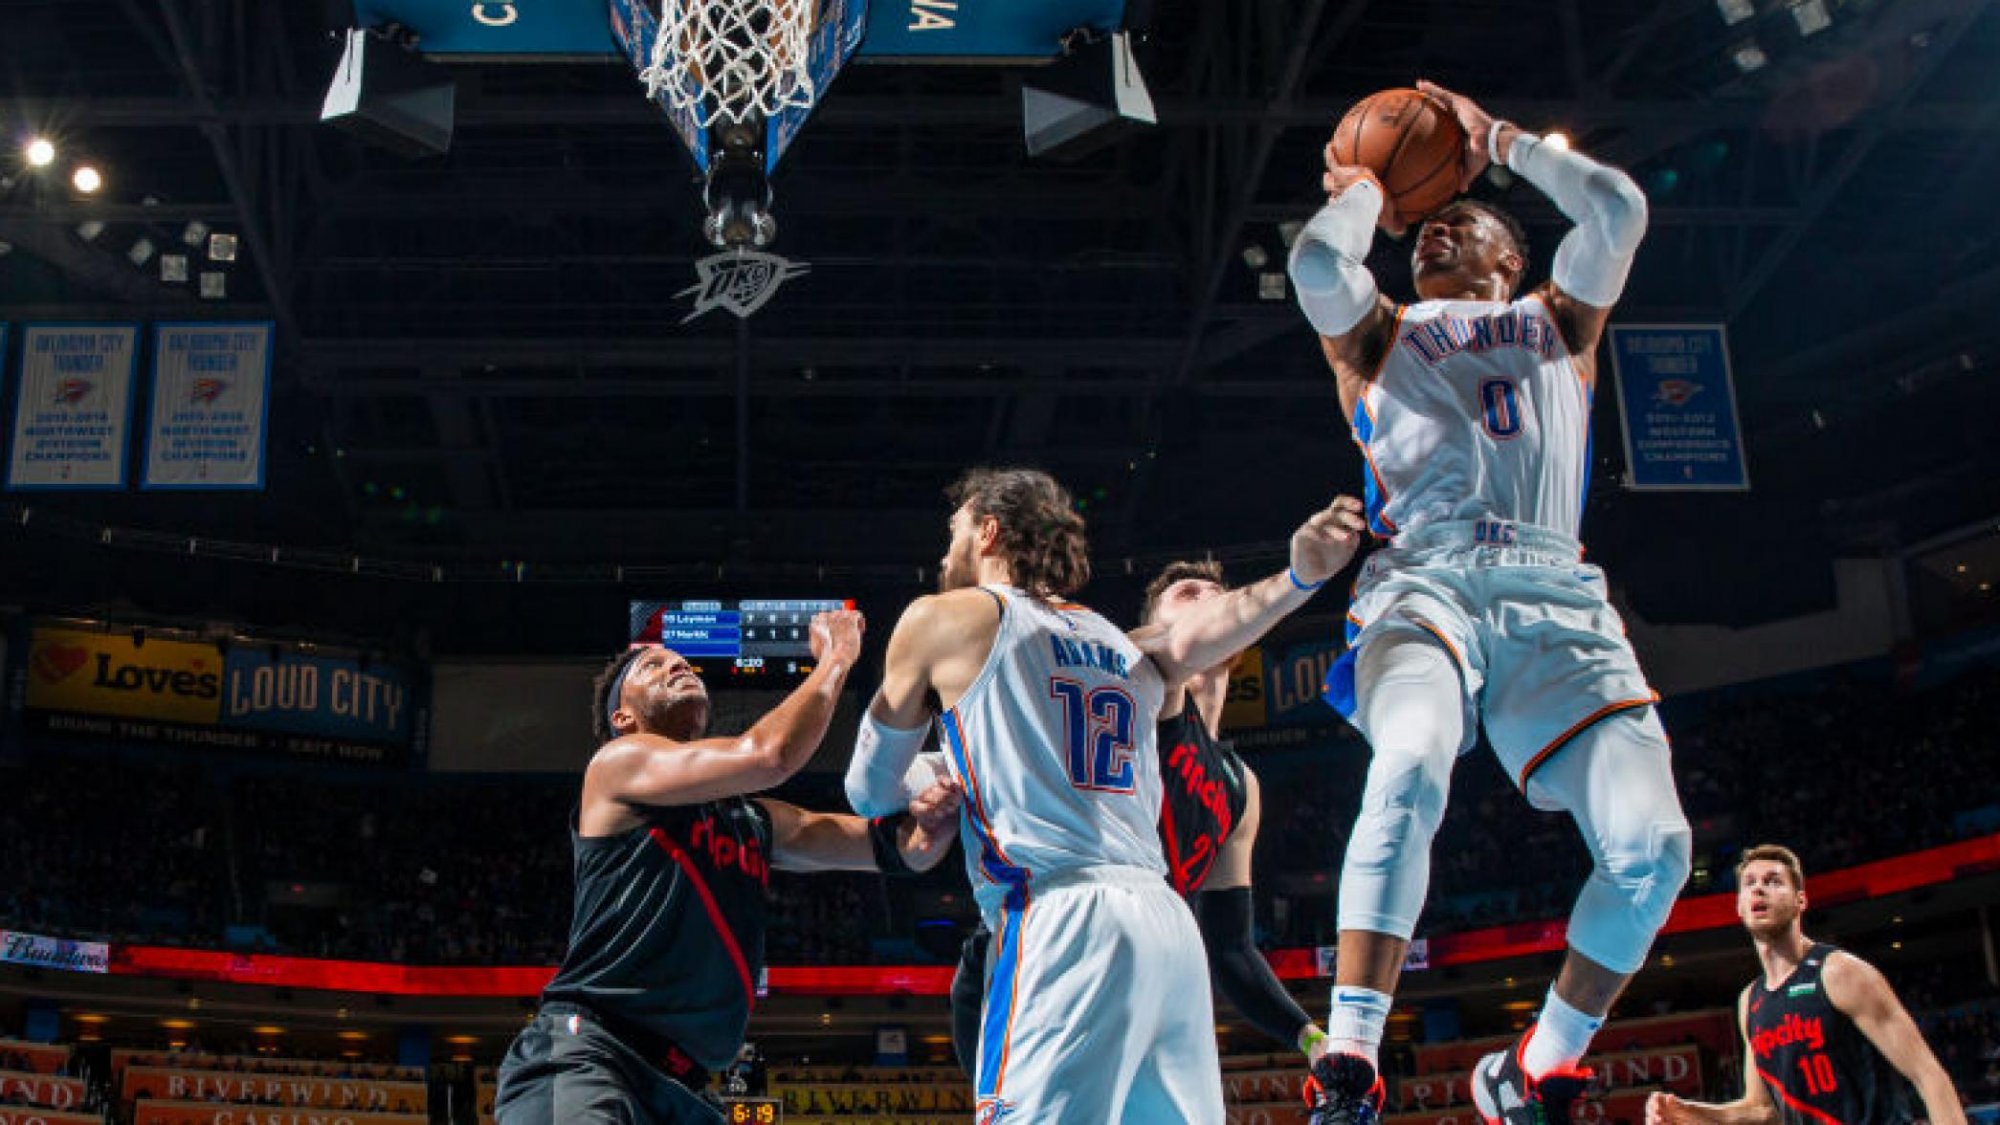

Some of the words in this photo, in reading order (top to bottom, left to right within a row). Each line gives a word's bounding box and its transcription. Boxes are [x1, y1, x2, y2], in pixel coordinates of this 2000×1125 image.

[1400, 311, 1557, 365] THUNDER
[1477, 375, 1525, 441] 0
[1050, 632, 1130, 681] ADAMS
[230, 662, 320, 717] LOUD
[331, 666, 403, 731] CITY
[1050, 676, 1137, 795] 12
[1798, 1053, 1838, 1097] 10
[733, 1103, 774, 1123] 6:19
